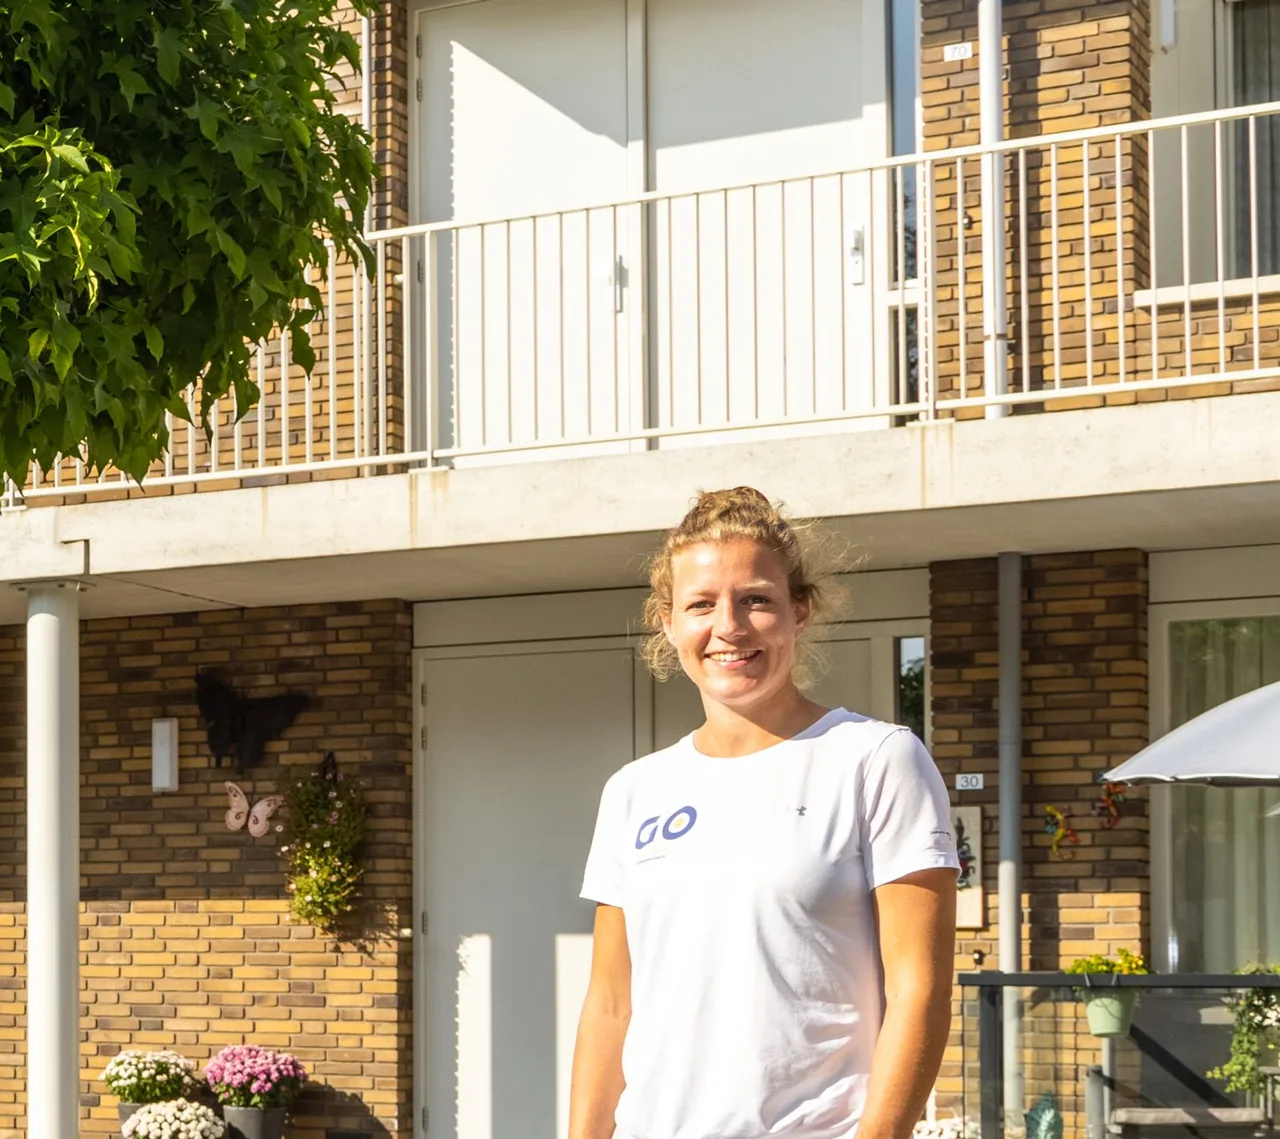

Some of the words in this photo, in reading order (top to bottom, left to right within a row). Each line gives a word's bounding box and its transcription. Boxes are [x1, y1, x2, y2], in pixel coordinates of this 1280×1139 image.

[948, 45, 968, 58] 70
[960, 775, 979, 788] 30
[635, 805, 698, 850] GO
